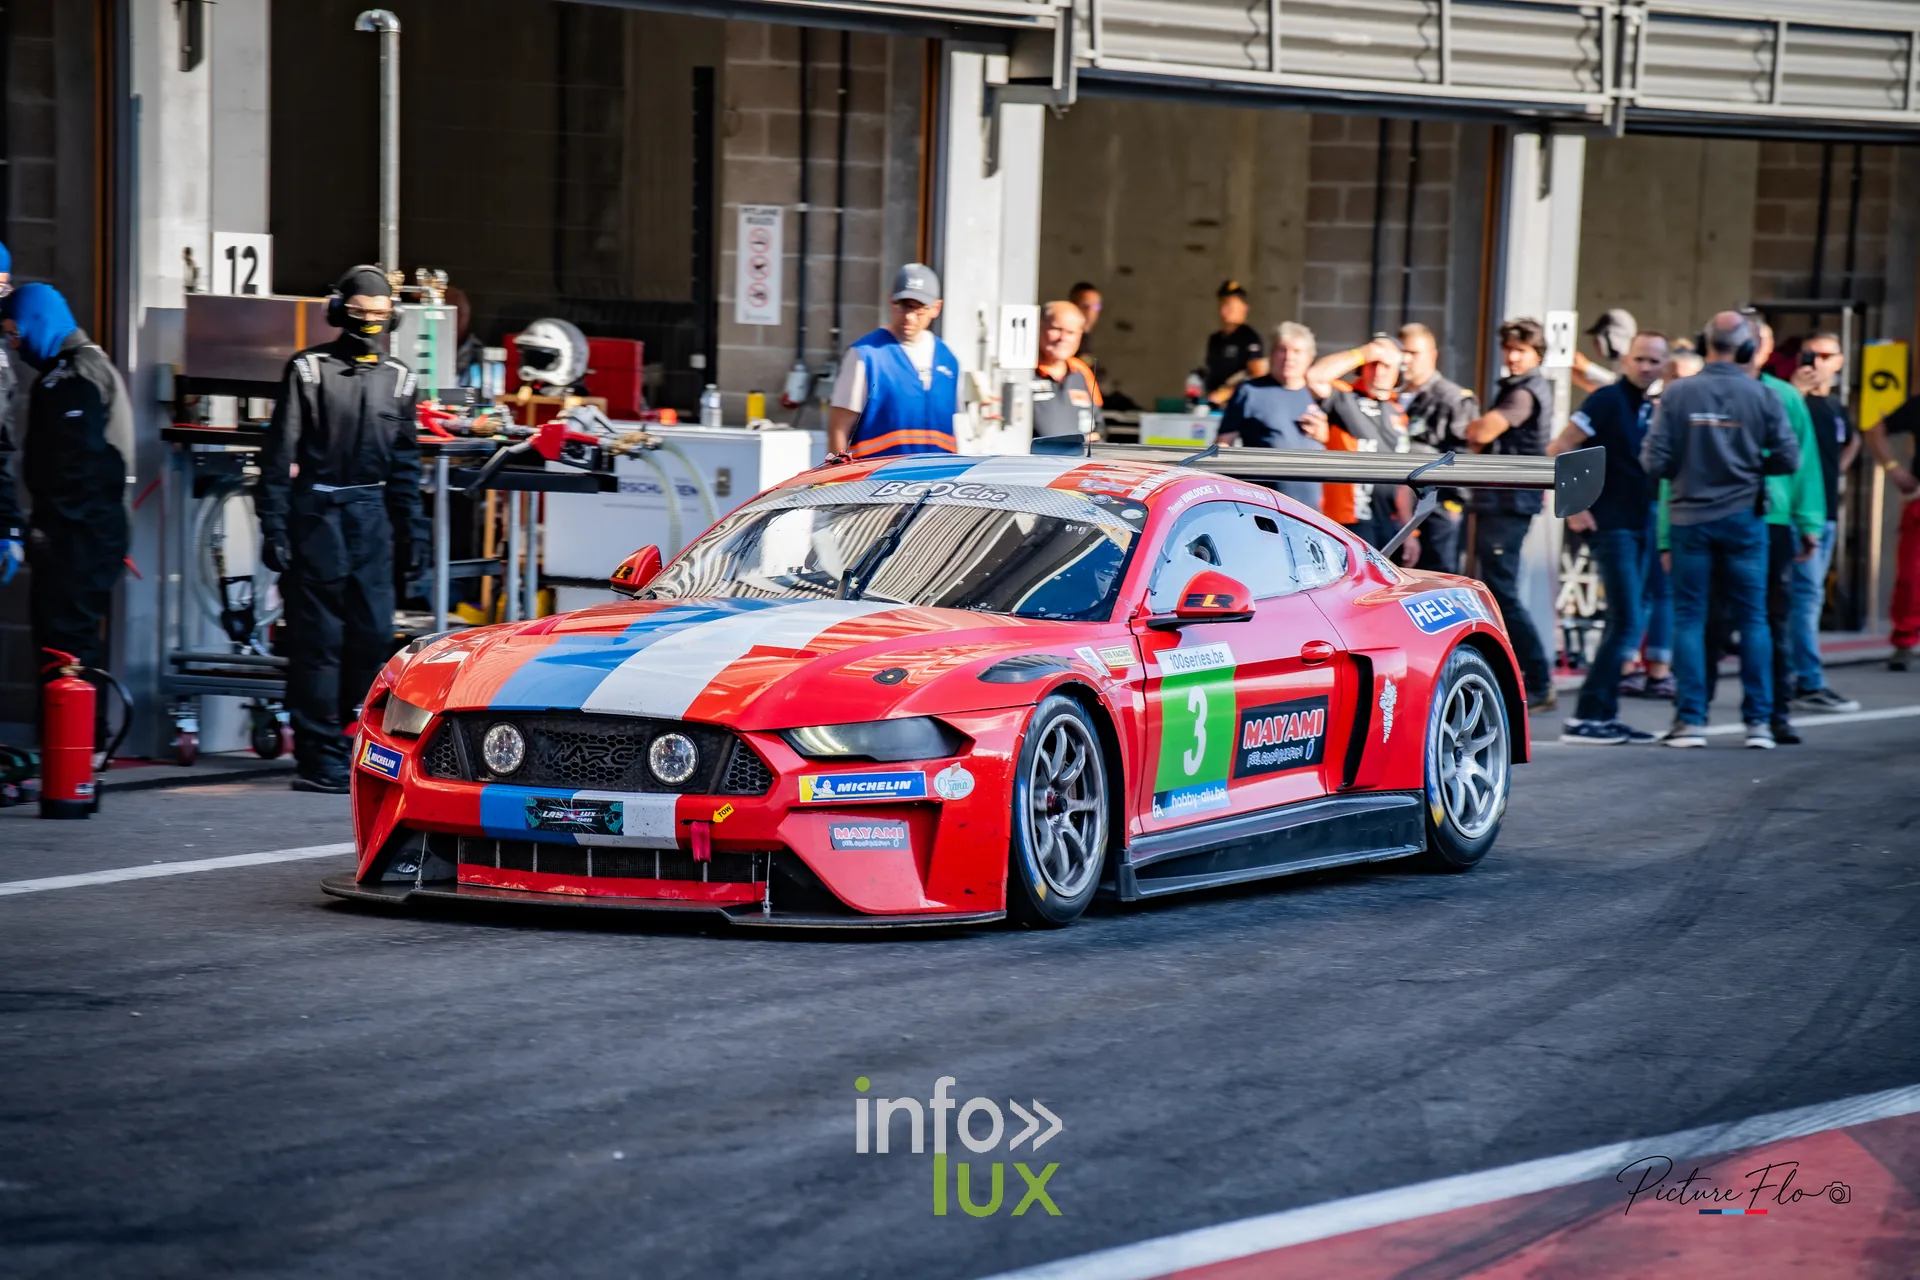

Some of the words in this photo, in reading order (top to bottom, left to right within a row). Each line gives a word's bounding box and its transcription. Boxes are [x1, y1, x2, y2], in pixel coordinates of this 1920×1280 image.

[224, 245, 259, 295] 12
[869, 480, 1010, 502] BGDC.be
[1184, 593, 1235, 608] ELR
[1168, 648, 1226, 670] 100series.be
[1183, 686, 1208, 776] 3
[1243, 708, 1325, 750] MAYAMI
[370, 752, 396, 769] MICHELIN
[836, 780, 912, 792] MICHELIN
[717, 805, 732, 818] TOW
[833, 827, 905, 839] MAYAMI
